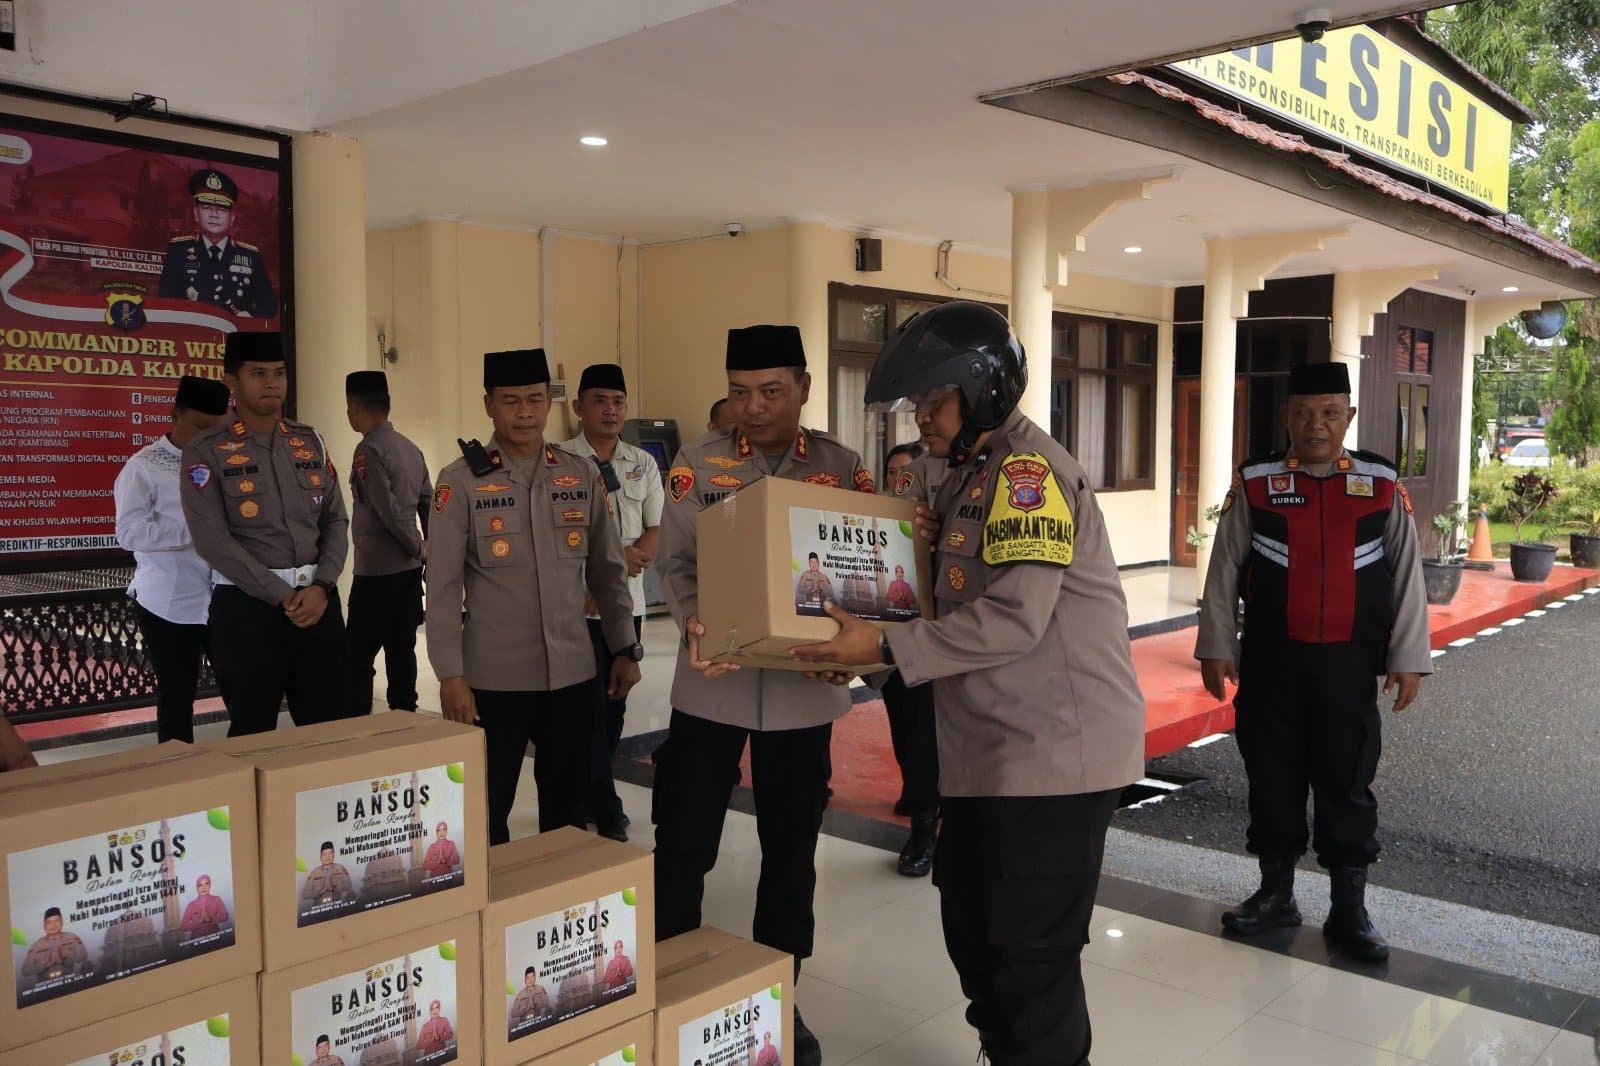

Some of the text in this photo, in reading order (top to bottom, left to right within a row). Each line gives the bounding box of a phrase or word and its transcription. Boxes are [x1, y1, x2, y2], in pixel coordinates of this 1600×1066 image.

[1217, 59, 1349, 137] RESPONSIBILITAS,
[1355, 124, 1433, 173] TRANSPARANSI
[1437, 163, 1493, 203] BERKEADILAN
[95, 258, 162, 274] KAPOLDA KALTIM
[184, 340, 225, 361] WIS
[4, 353, 137, 377] KAPOLDA
[10, 390, 55, 399] INTERNAL
[4, 416, 39, 424] NEGARA
[21, 407, 63, 416] PROGRAM
[64, 409, 126, 418] PEMBANGUNAN
[16, 430, 62, 438] KEAMANAN
[82, 430, 126, 439] KETERTIBAN
[16, 454, 76, 463] TRANSFORMASI
[77, 455, 106, 463] DIGITAL
[27, 475, 57, 484] MEDIA
[43, 490, 61, 498] DAN
[551, 490, 588, 502] POLRI
[1271, 497, 1305, 505] SUBEKI
[28, 499, 57, 508] PUBLIK
[475, 496, 516, 510] AHMAD
[13, 517, 45, 526] KHUSUS
[46, 516, 81, 525] WILAYAH
[82, 515, 116, 525] PRIORITA
[819, 523, 888, 547] BANSOS
[1006, 549, 1045, 558] SANGATTA
[1007, 541, 1047, 550] SANGATTA
[337, 784, 430, 823] BANSOS
[340, 847, 355, 856] Nabi
[356, 839, 392, 852] Muhammad
[393, 834, 407, 844] SAW
[345, 829, 389, 846] Memperingati
[63, 834, 187, 885] BANSOS
[84, 864, 169, 894] Dalam Rangka
[76, 887, 134, 910] Memperingati
[135, 885, 152, 896] Isra
[70, 911, 90, 924] Nabi
[91, 898, 139, 917] Muhammad
[140, 892, 158, 905] SAW
[92, 904, 167, 931] Polres Kutai Timur
[537, 909, 610, 950] BANSOS
[332, 966, 423, 1015] BANSOS
[335, 1036, 350, 1048] Nabi
[387, 1017, 401, 1029] SAW
[703, 1005, 760, 1044] BANSOS
